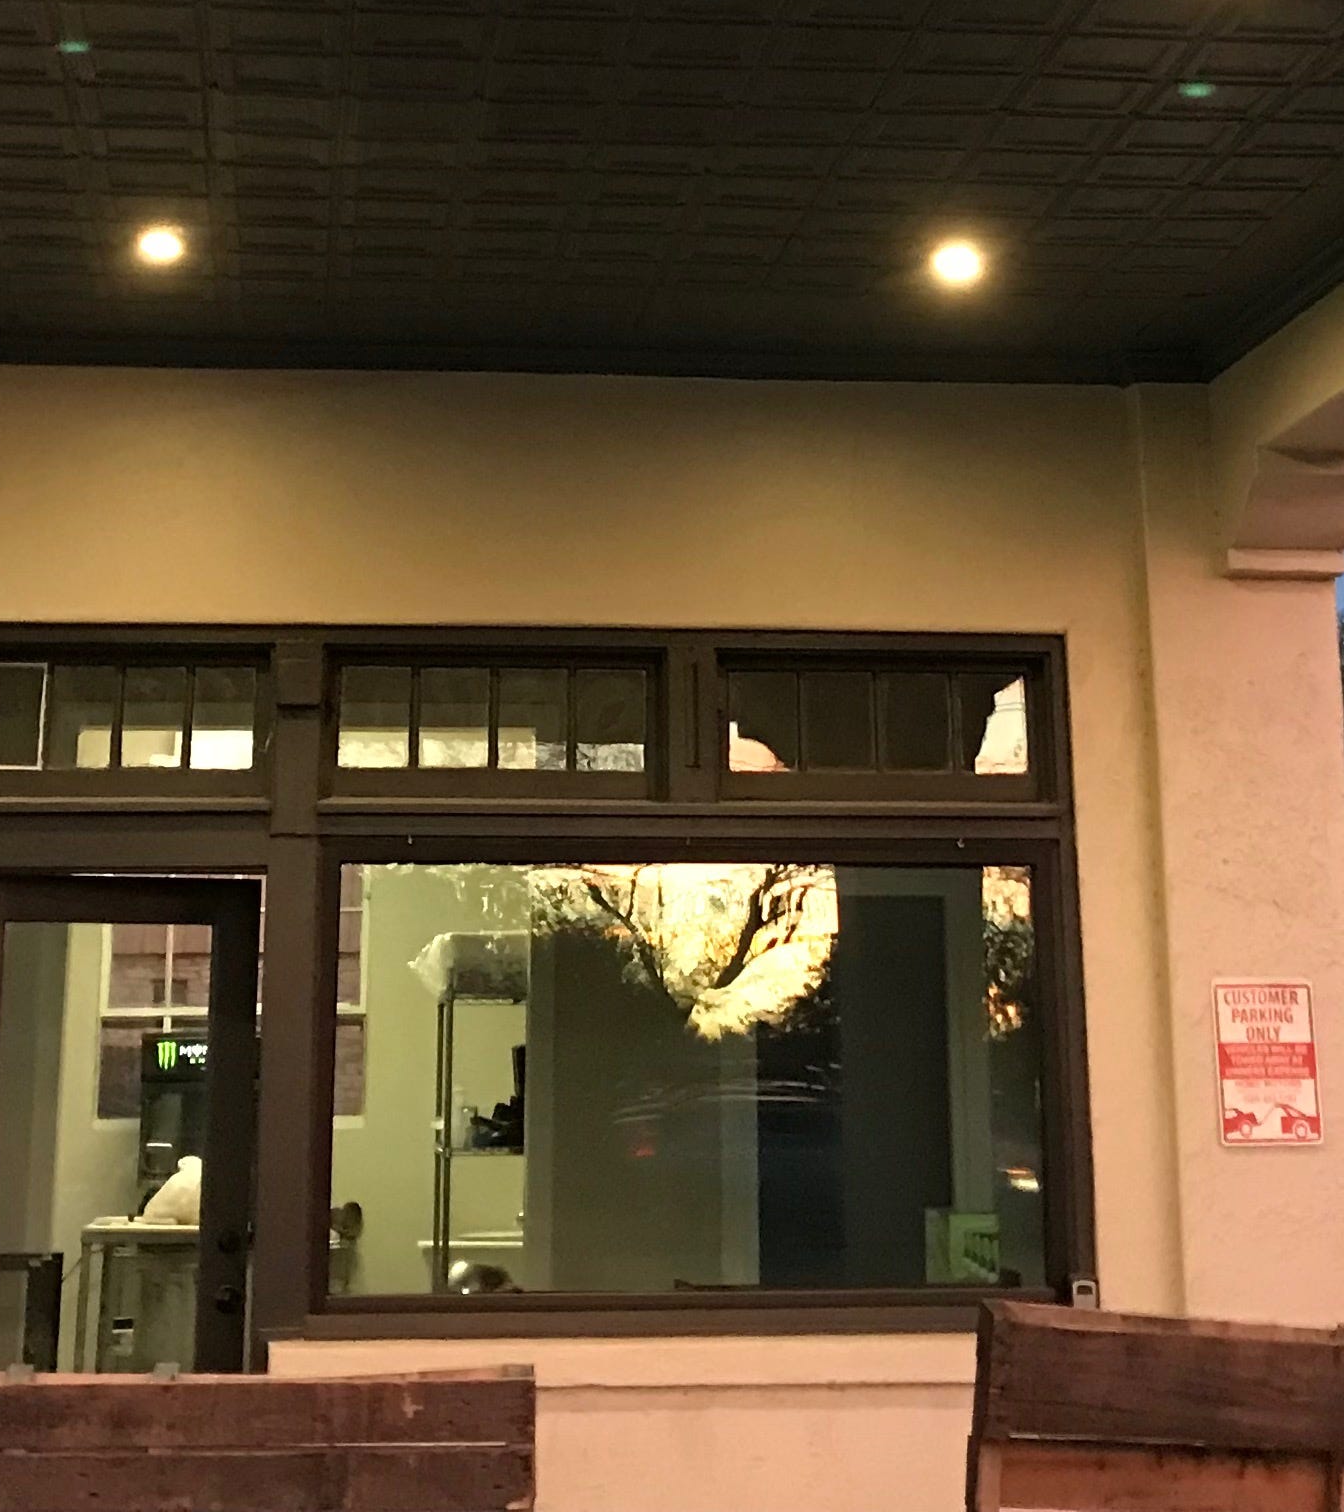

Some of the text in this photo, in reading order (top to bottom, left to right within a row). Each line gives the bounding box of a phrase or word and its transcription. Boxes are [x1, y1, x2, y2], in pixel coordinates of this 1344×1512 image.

[1224, 991, 1299, 1006] CUSTOMER
[1232, 1008, 1293, 1023] PARKING
[1246, 1026, 1281, 1041] ONLY
